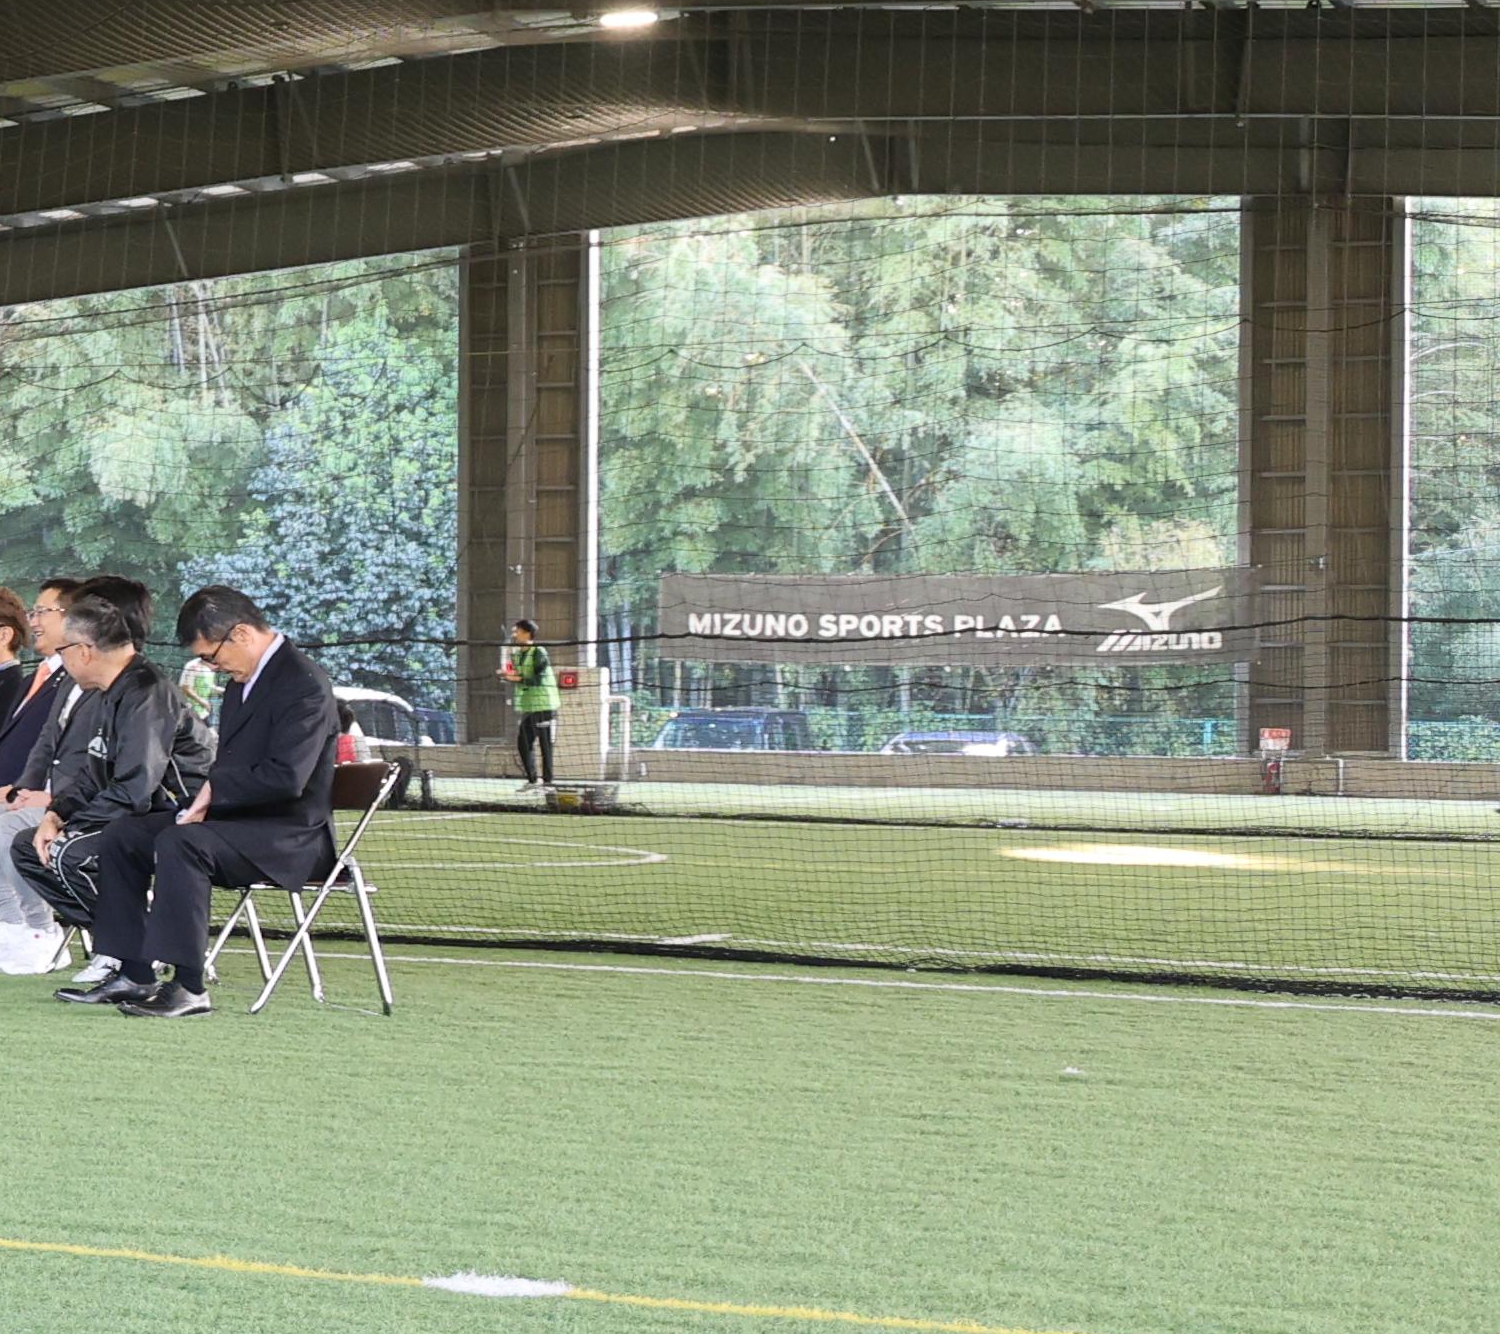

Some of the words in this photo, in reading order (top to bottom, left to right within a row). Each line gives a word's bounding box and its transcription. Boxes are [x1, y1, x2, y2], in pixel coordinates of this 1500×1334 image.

[688, 613, 809, 637] MIZUNO
[817, 614, 943, 638] SPORTS
[953, 614, 1067, 638] PLAZA
